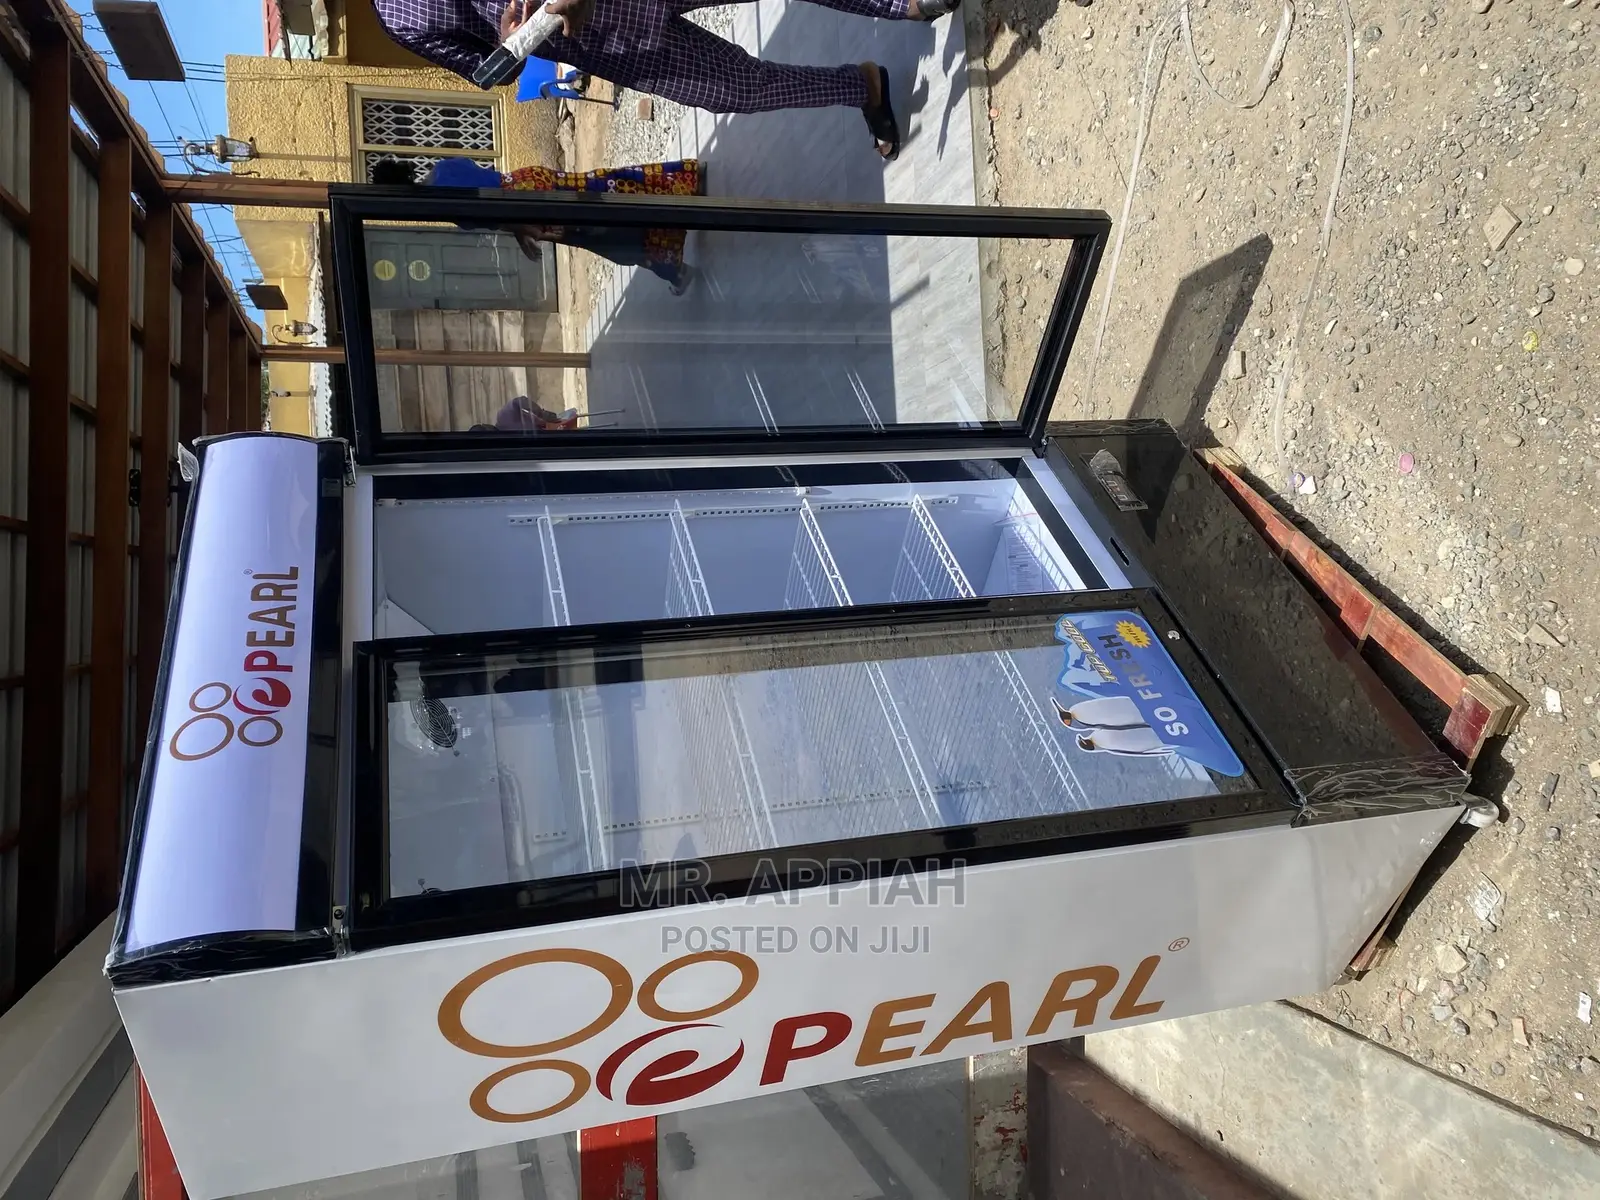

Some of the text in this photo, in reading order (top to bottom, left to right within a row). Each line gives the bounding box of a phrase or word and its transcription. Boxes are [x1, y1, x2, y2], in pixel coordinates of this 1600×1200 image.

[243, 566, 299, 673] PEARL
[1060, 619, 1118, 682] TOP COOL
[1097, 633, 1190, 737] SO FRESH
[759, 955, 1165, 1086] PEARL
